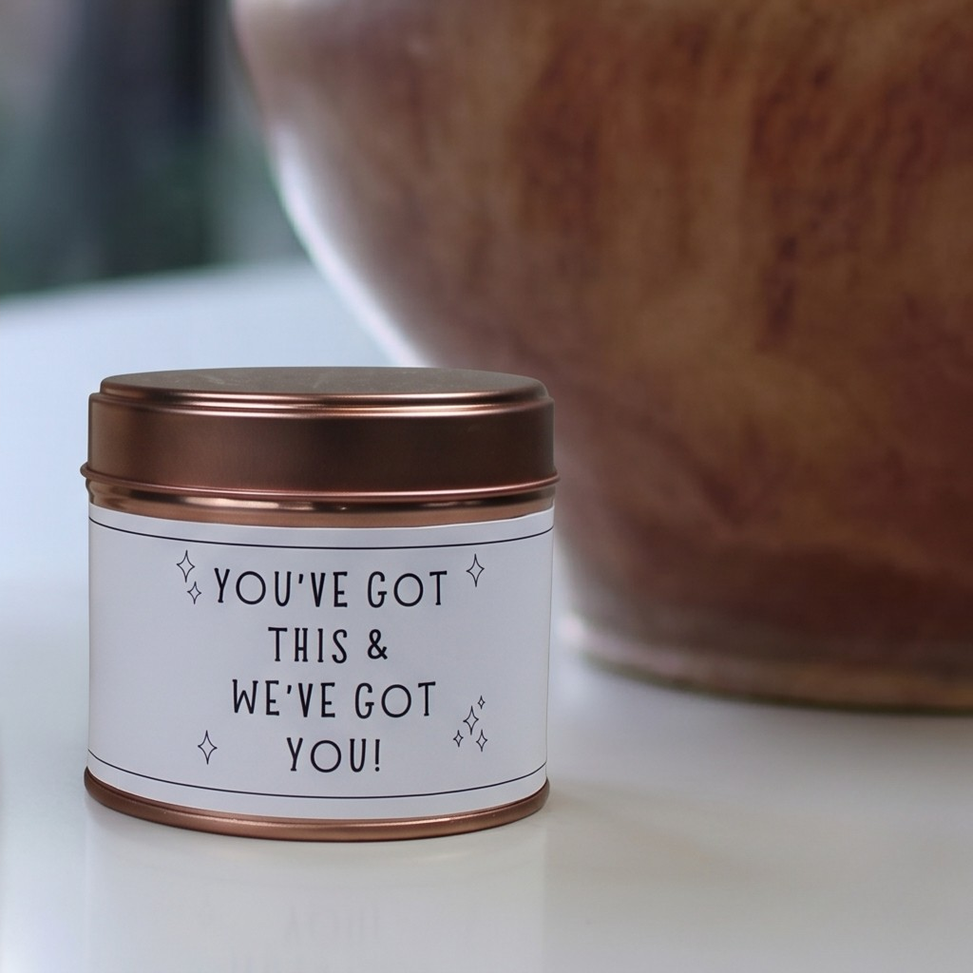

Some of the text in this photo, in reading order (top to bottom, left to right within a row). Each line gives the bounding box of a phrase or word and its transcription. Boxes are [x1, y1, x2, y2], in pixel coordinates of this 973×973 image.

[213, 567, 448, 609] YOU'VE GOT
[267, 626, 388, 664] THIS &
[232, 678, 437, 720] WE'VE GOT
[286, 736, 382, 774] YOU!
